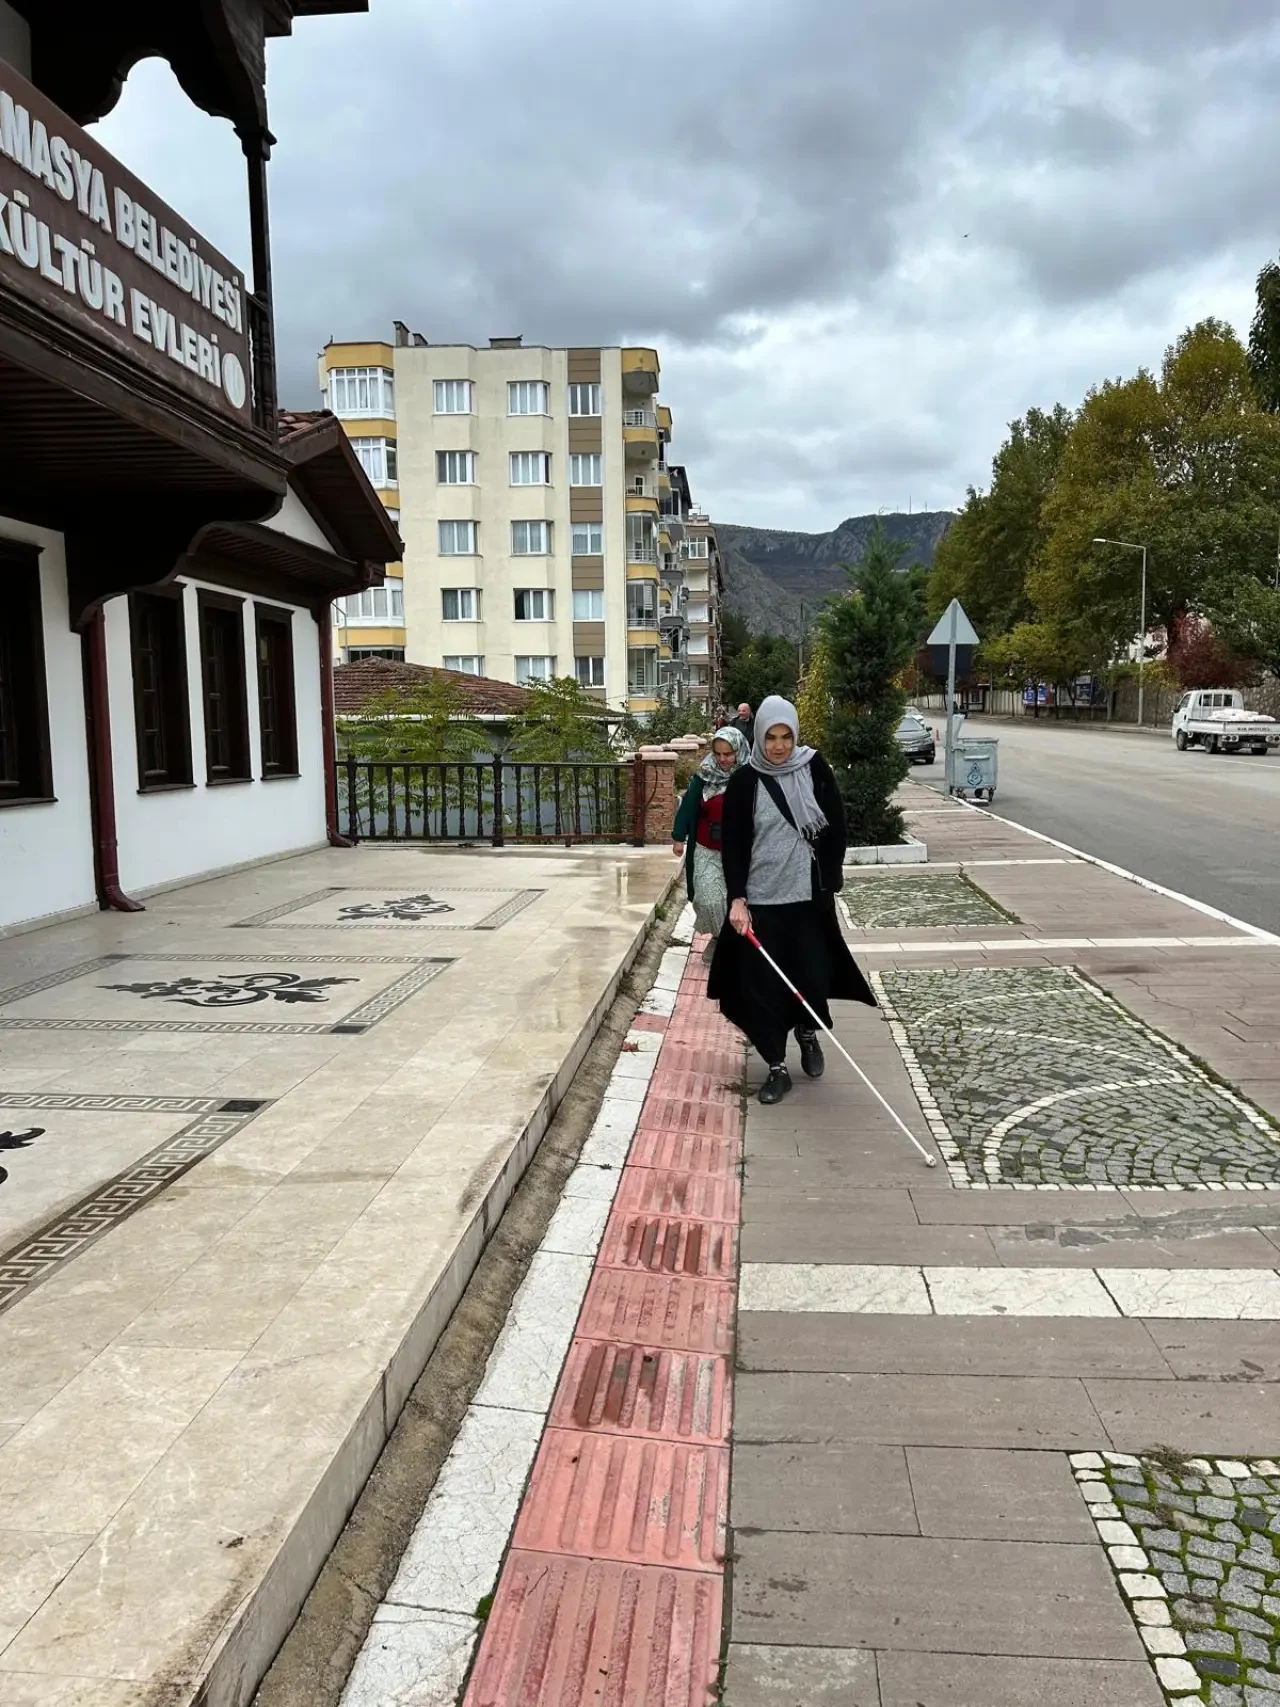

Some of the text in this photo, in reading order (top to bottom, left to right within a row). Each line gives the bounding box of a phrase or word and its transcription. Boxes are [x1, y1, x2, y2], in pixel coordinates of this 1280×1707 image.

[0, 90, 242, 334] MASYA BELEDİYESİ
[130, 287, 221, 388] EVLERİ
